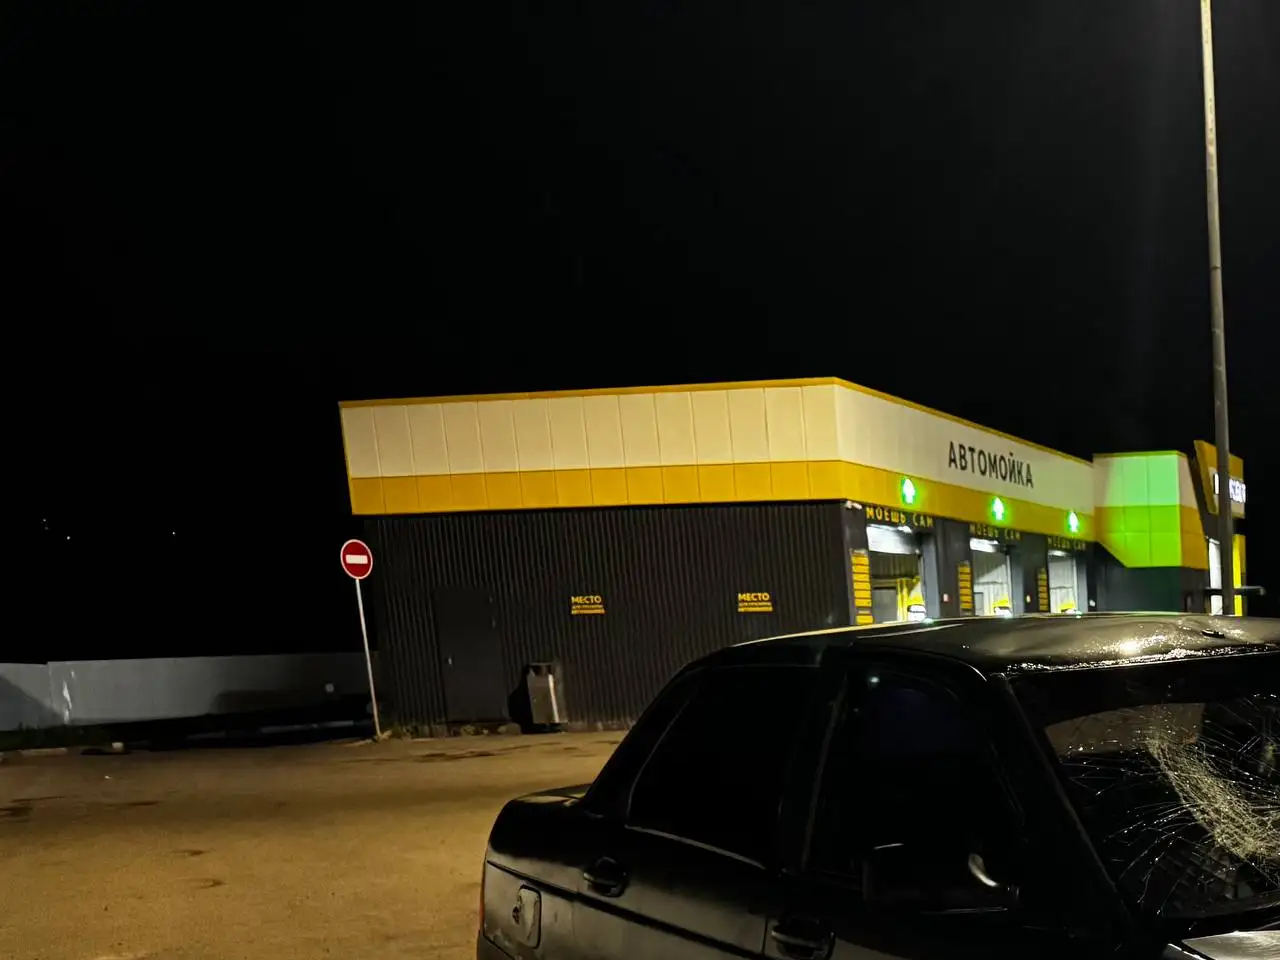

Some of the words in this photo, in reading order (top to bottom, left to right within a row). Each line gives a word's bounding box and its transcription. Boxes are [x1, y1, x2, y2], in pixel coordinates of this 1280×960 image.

[948, 440, 1034, 489] АВТОМОЙКА
[866, 506, 906, 525] МОЕШЬ
[912, 512, 934, 529] САМ
[737, 592, 770, 601] МЕСТО
